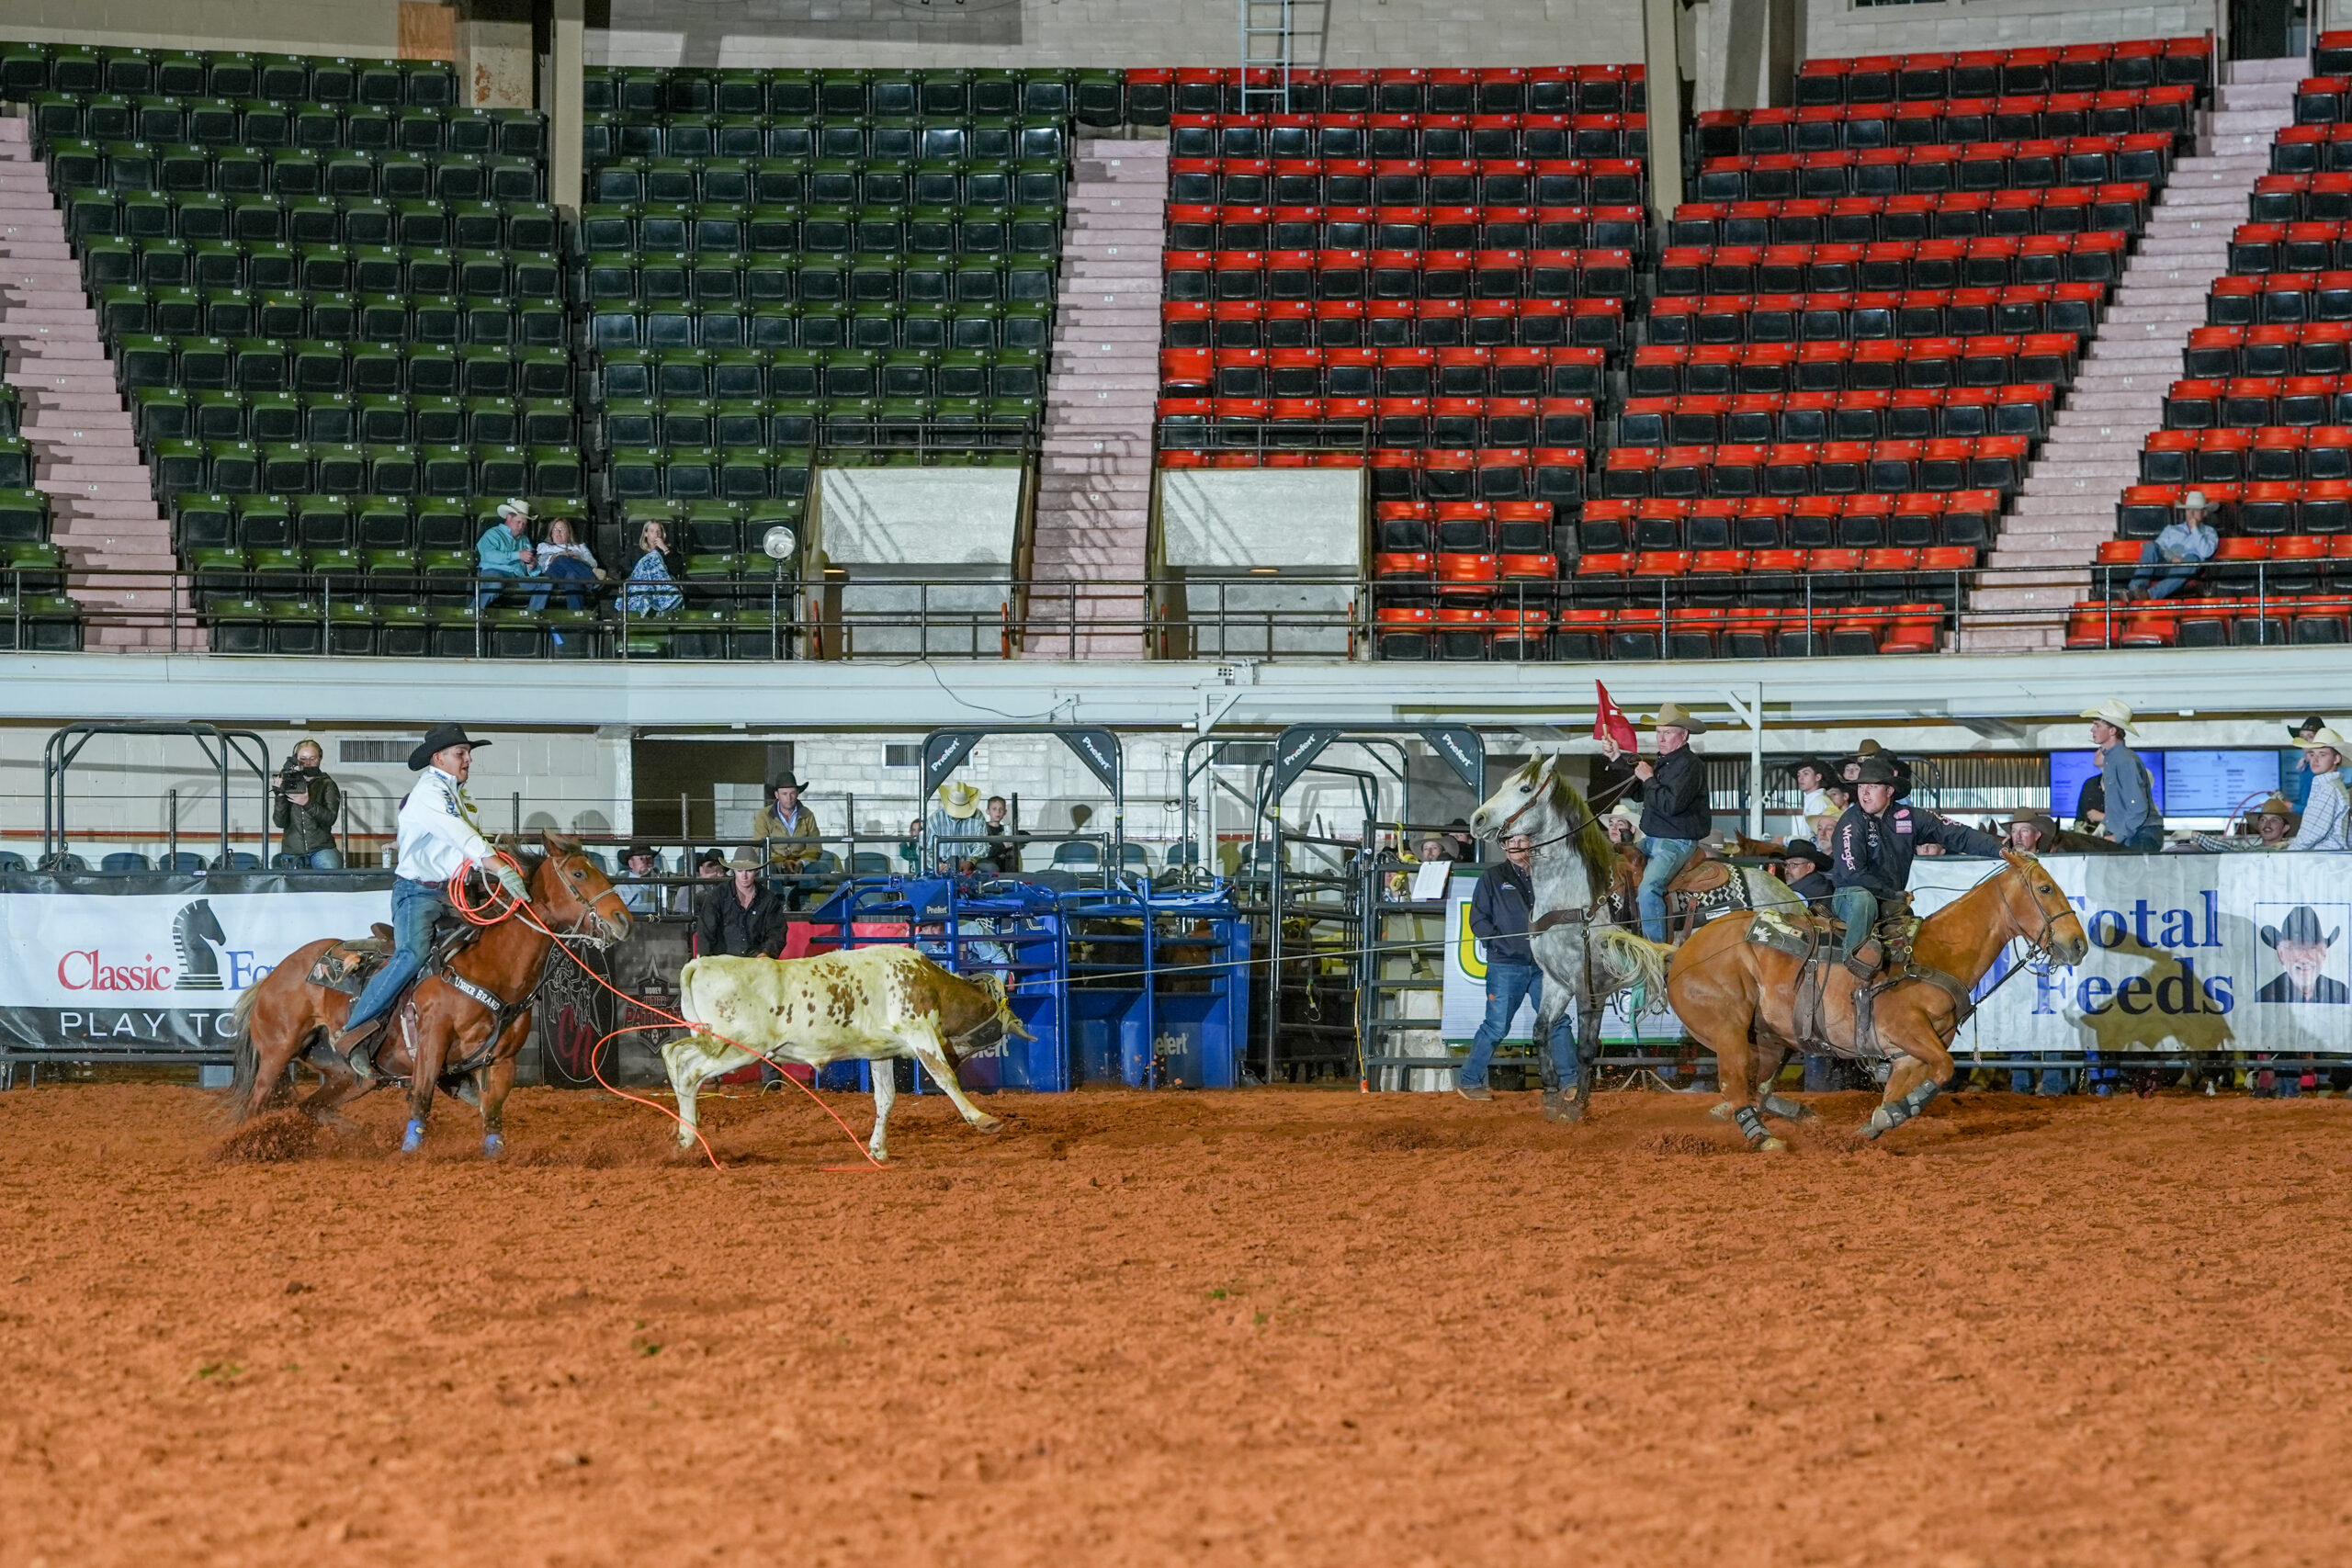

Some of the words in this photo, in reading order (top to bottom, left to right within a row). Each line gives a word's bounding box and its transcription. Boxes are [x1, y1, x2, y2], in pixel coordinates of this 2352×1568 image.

[931, 739, 959, 772] Priefert
[1082, 737, 1110, 770] Priefert
[1283, 734, 1316, 766] Priefert
[1442, 733, 1472, 766] Priefert
[1841, 824, 1856, 871] Wrangler
[58, 950, 171, 991] Classic
[2031, 957, 2234, 1015] Feeds
[475, 989, 500, 1010] BRAND
[61, 1012, 165, 1037] PLAY
